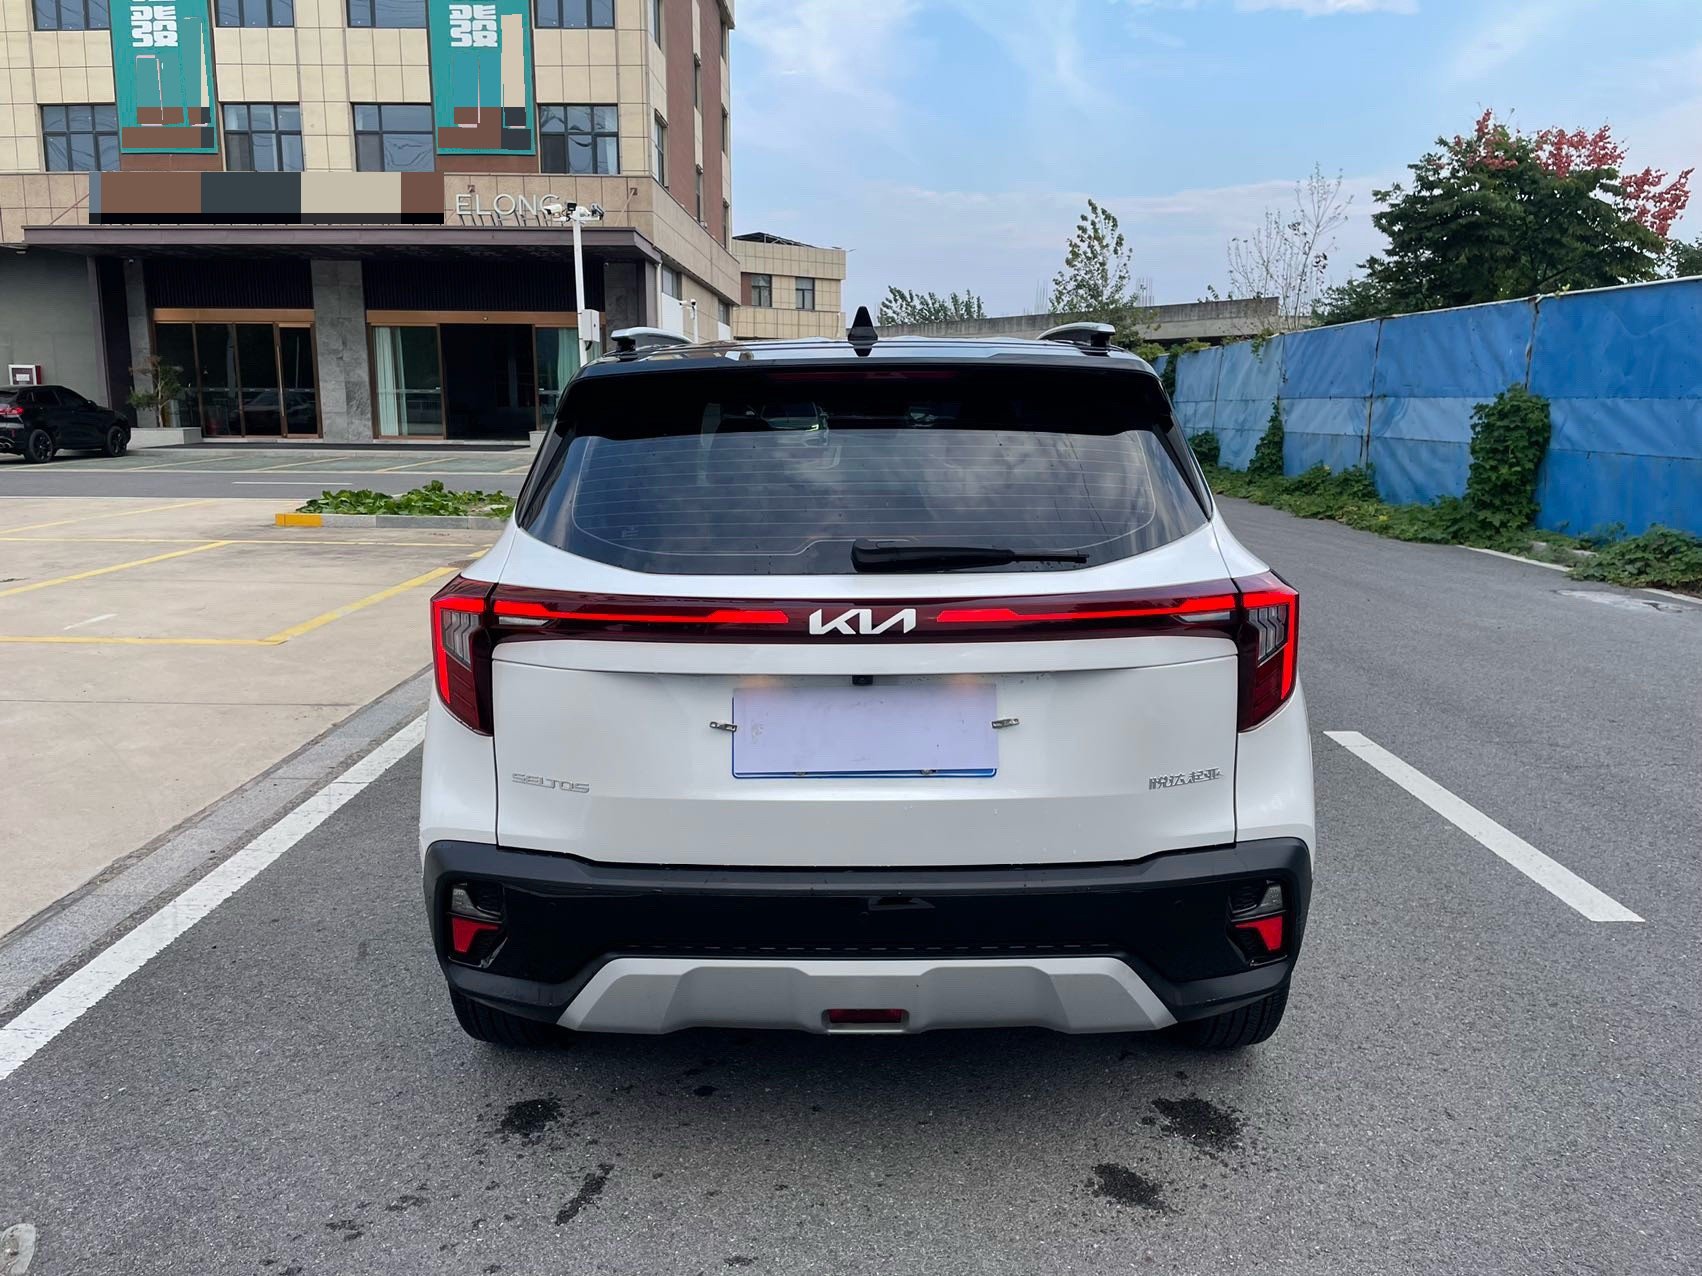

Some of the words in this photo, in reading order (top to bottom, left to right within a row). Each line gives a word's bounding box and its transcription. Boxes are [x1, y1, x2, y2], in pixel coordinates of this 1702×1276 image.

[130, 0, 179, 47] 發
[809, 608, 917, 635] KIA
[511, 773, 590, 794] SELTOS
[1148, 767, 1223, 790] 悦达起亚
